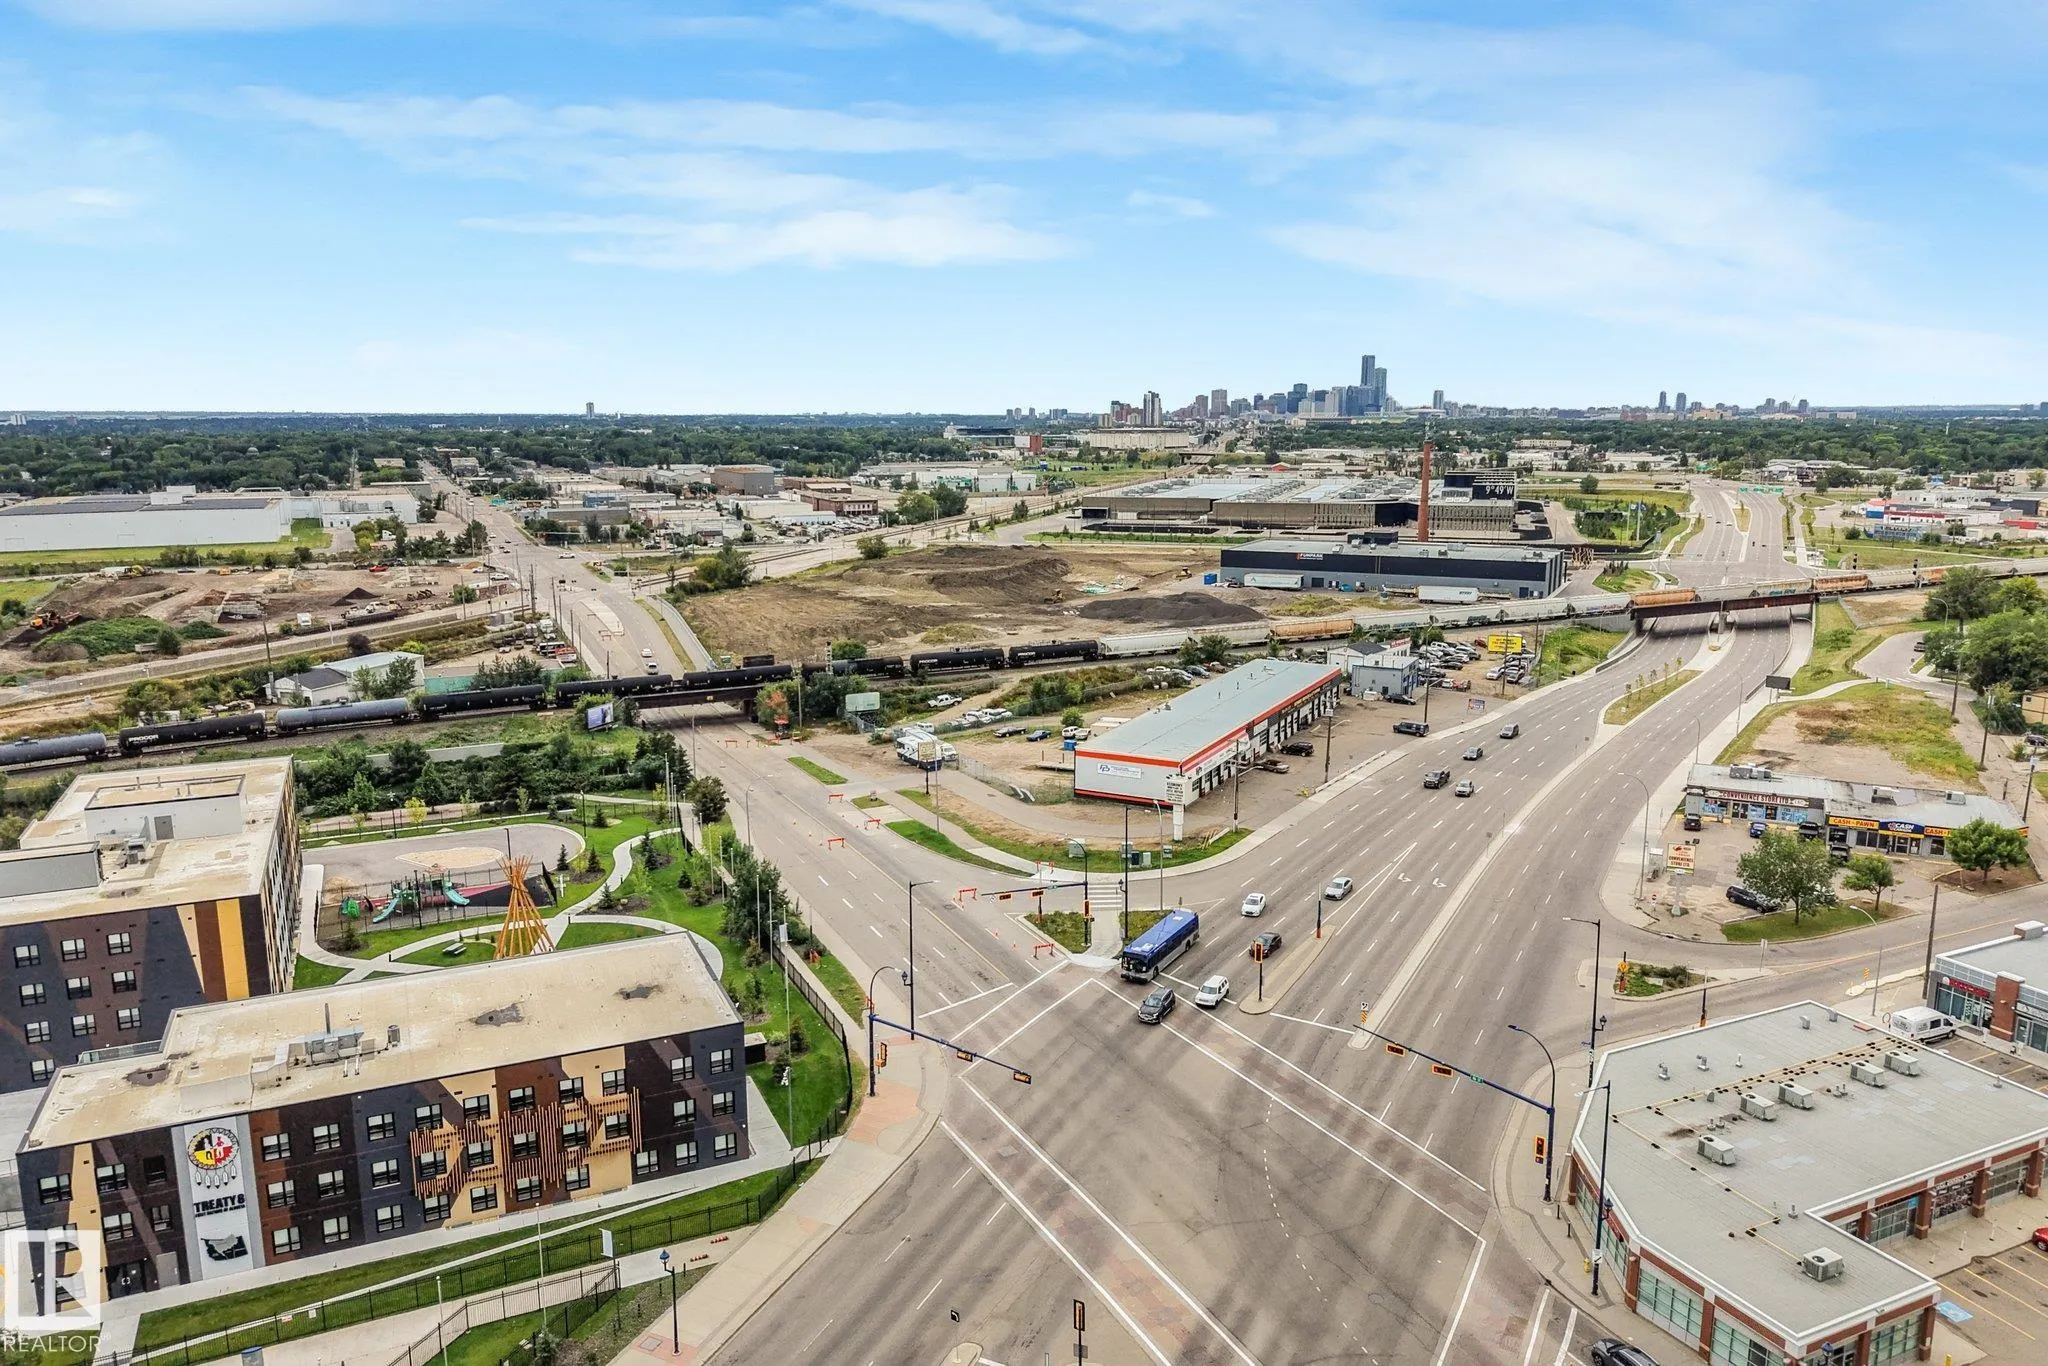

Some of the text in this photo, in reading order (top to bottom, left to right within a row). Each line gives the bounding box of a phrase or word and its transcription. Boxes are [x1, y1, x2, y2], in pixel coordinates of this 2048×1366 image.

[128, 734, 159, 742] PROCOR
[1925, 828, 1945, 836] CASH
[193, 1193, 245, 1213] TREATY 8
